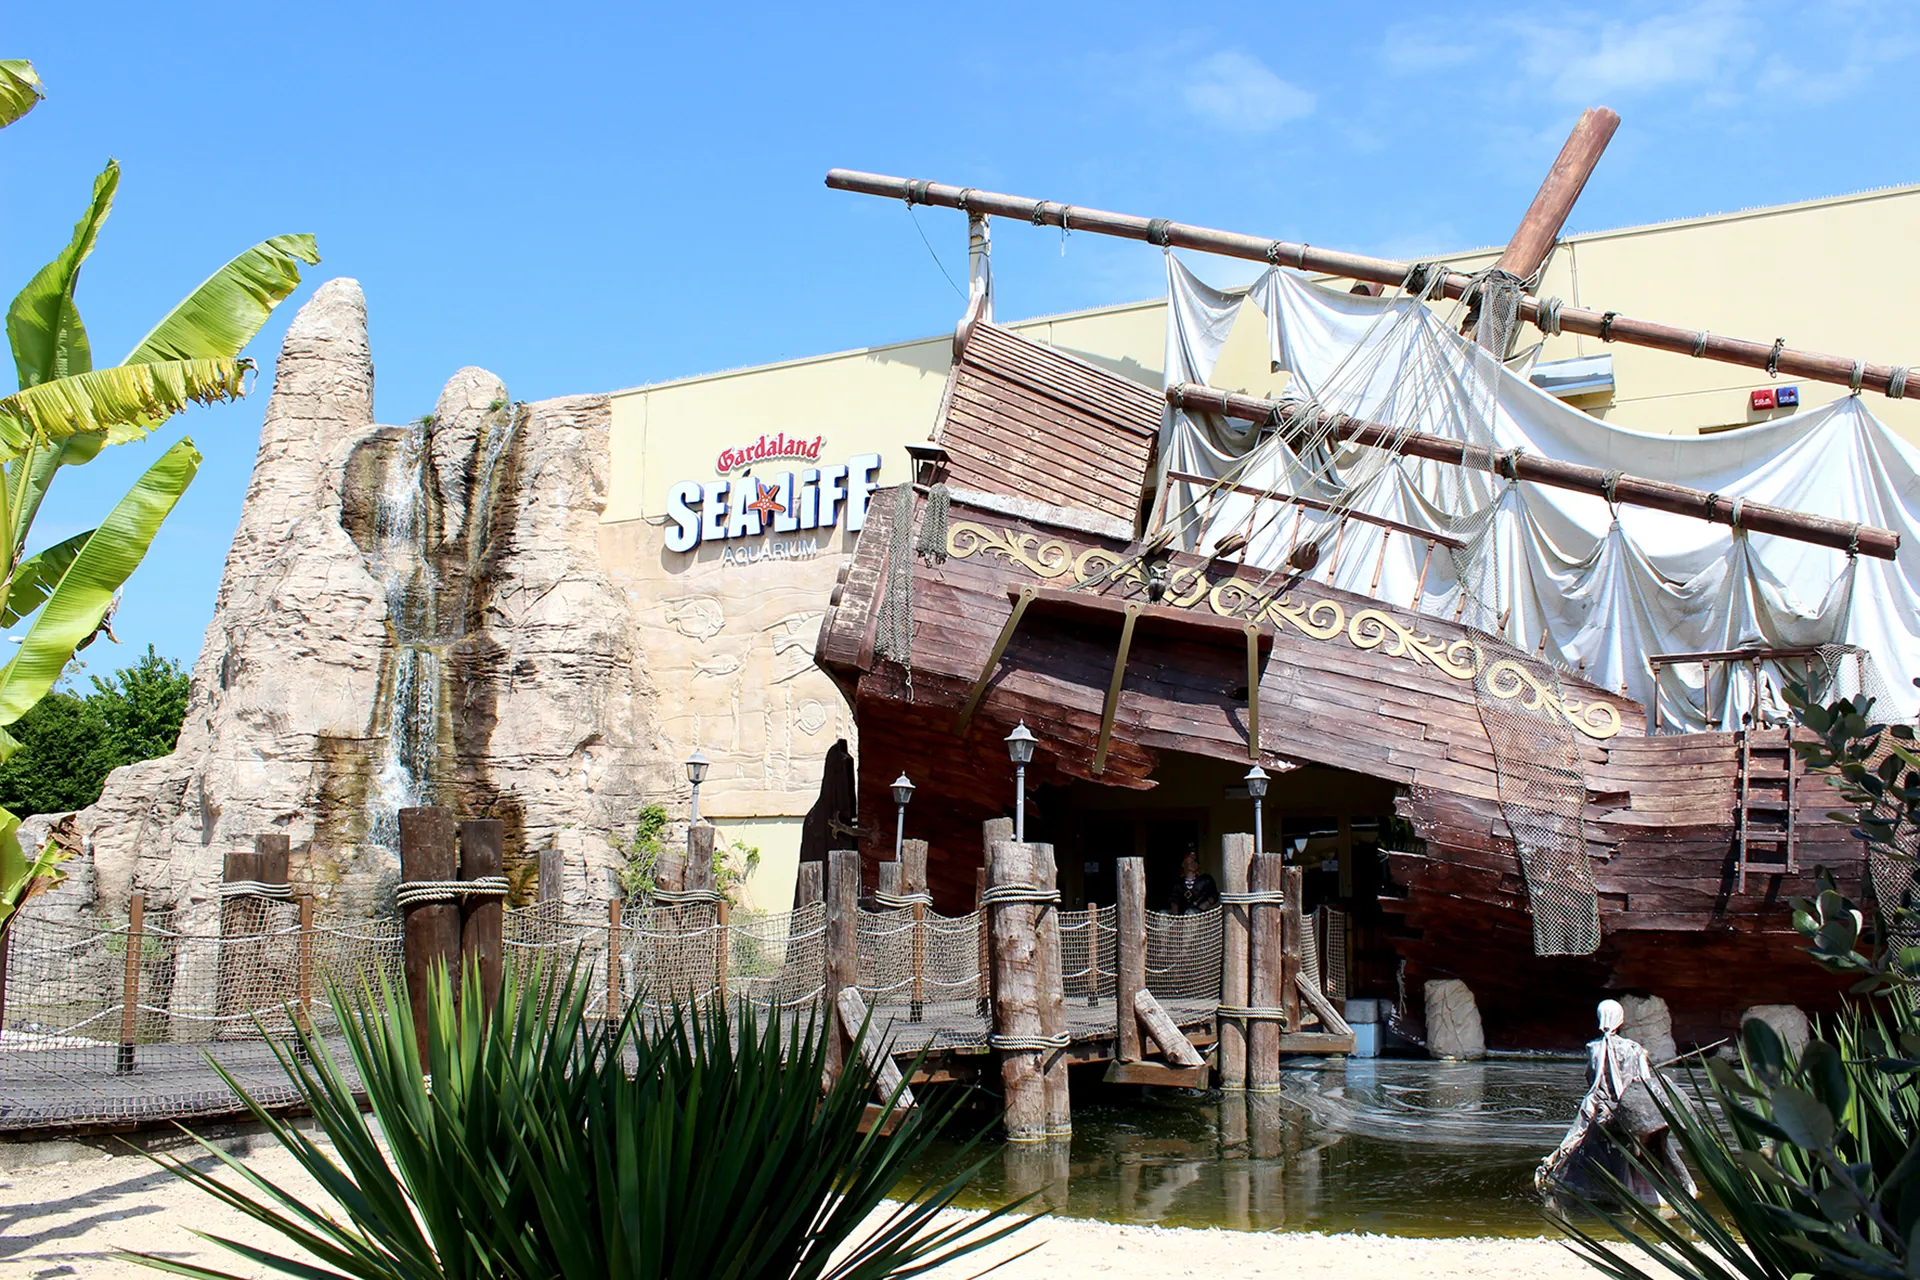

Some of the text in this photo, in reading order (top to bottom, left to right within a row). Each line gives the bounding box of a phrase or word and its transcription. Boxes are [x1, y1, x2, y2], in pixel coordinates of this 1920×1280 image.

[716, 432, 823, 473] Gardaland
[664, 476, 763, 552] SEA
[722, 539, 818, 565] AQUARIUM
